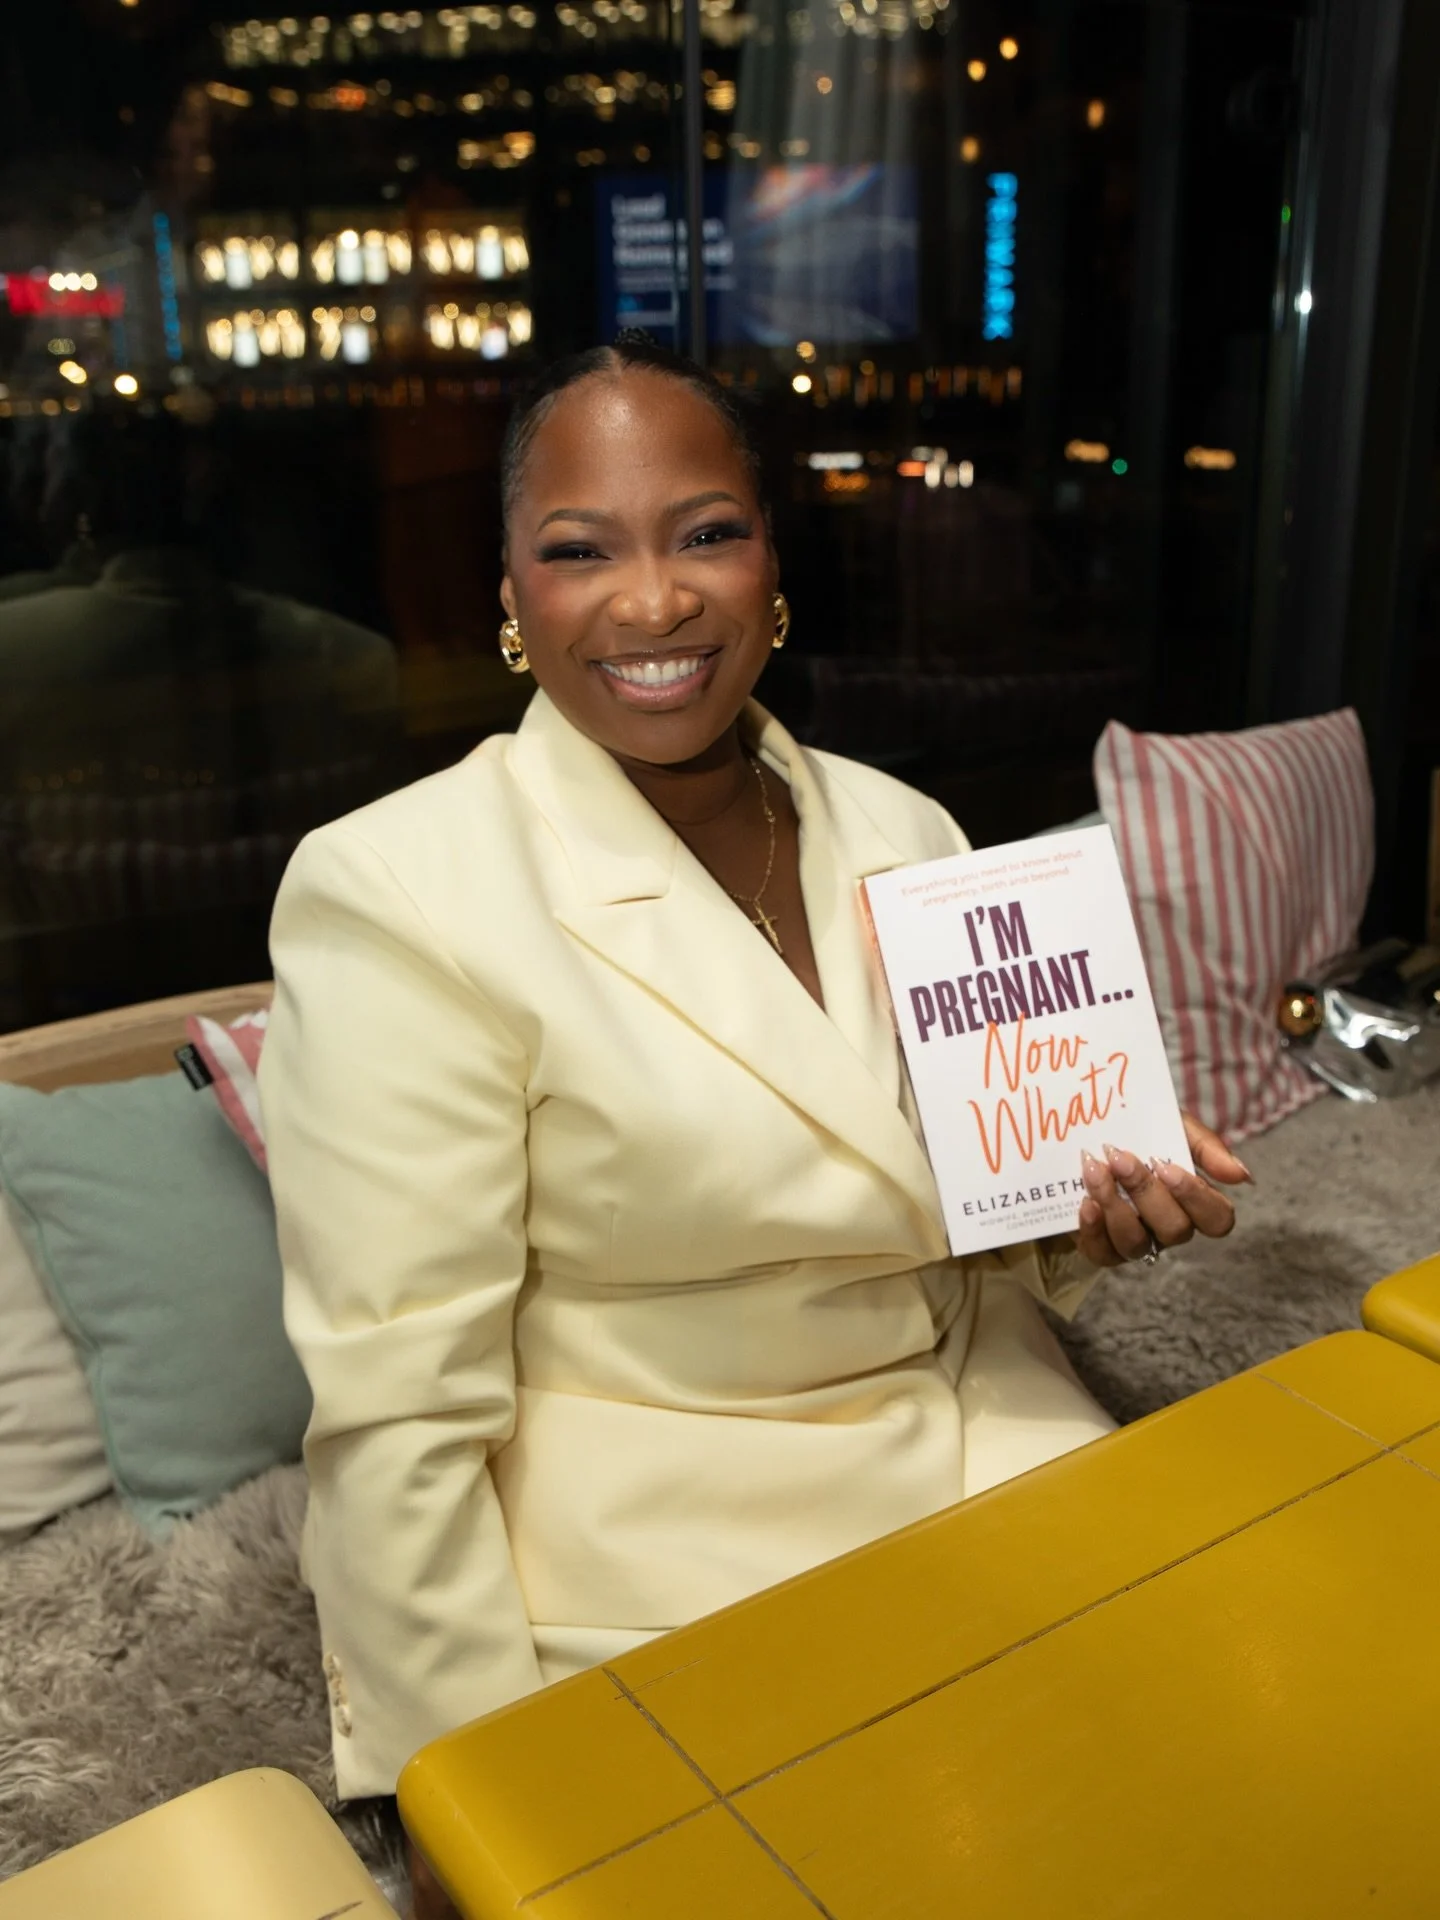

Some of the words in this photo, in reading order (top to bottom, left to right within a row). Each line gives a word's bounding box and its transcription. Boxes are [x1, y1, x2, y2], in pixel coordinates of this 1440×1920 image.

[901, 877, 958, 897] Everything
[960, 873, 979, 885] you
[981, 864, 1007, 877] need
[1009, 862, 1020, 872] to
[1022, 857, 1050, 868] know
[1053, 850, 1083, 862] about
[981, 880, 1008, 892] birth
[1009, 875, 1029, 887] and
[1031, 866, 1070, 881] beyond
[963, 901, 1032, 967] I'M
[909, 949, 1134, 1043] PREGNANT...
[985, 1011, 1088, 1092] Now
[968, 1052, 1128, 1174] What?
[962, 1178, 1085, 1215] ELIZABETH
